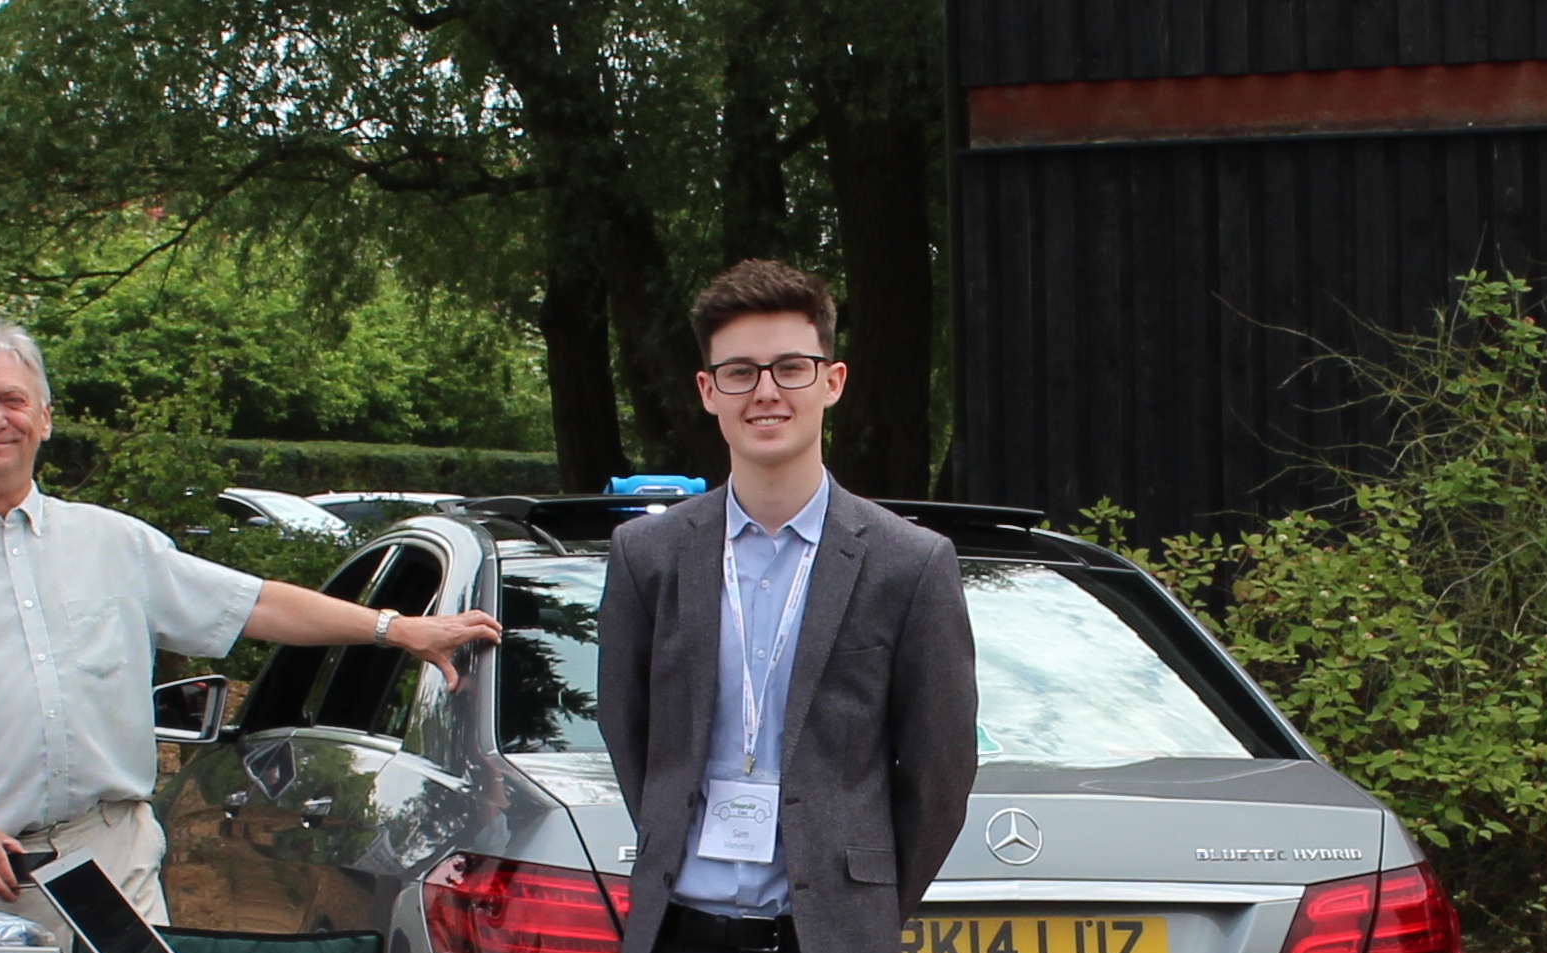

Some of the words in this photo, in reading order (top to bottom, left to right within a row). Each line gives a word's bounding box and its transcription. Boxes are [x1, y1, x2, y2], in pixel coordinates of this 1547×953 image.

[733, 829, 749, 838] Sam
[1195, 848, 1287, 861] BLUETEC
[1293, 848, 1363, 861] HYBRID
